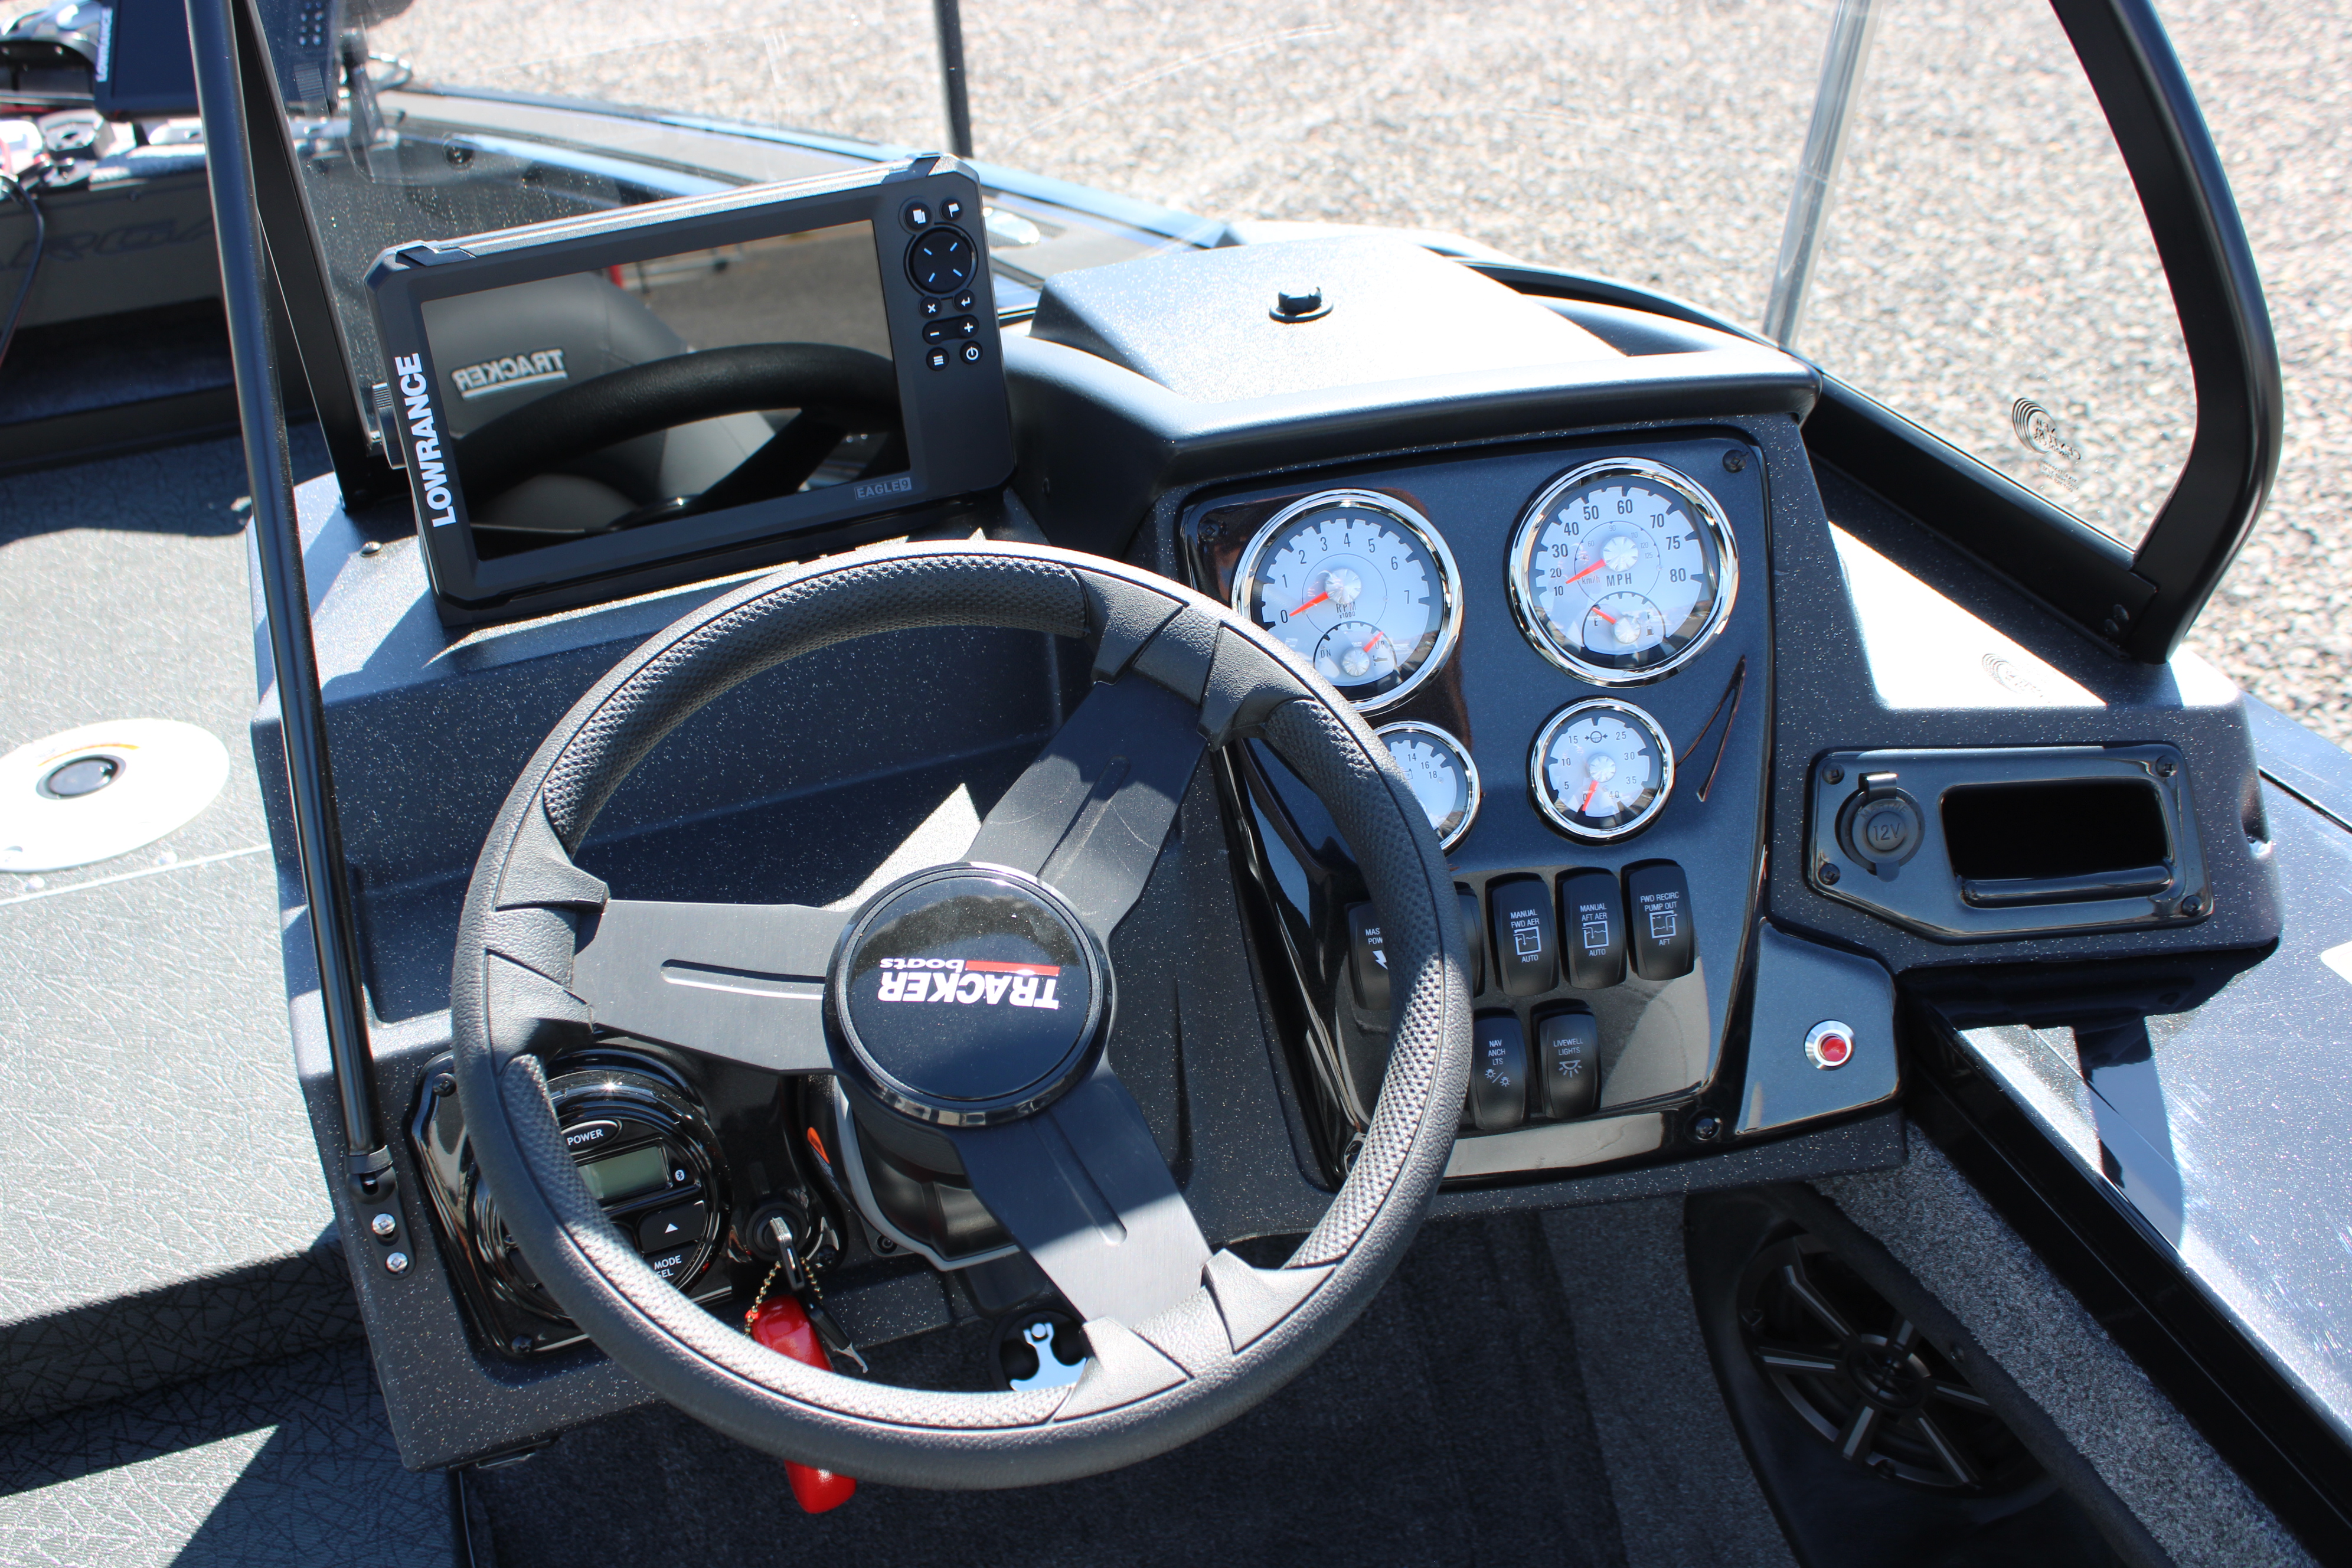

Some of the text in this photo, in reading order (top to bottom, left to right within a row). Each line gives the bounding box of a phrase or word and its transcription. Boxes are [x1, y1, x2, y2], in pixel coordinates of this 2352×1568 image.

[394, 352, 456, 528] LOWRANCE
[1617, 499, 1633, 514] 60
[1583, 505, 1599, 521] 50
[1650, 514, 1664, 529] 70
[1564, 522, 1580, 536] 40
[1320, 537, 1328, 551] 3
[1344, 533, 1351, 548] 4
[1368, 538, 1376, 553] 5
[1665, 535, 1681, 551] 75
[1552, 543, 1568, 558] 30
[1299, 550, 1306, 565] 2
[1391, 556, 1398, 570] 6
[1550, 568, 1562, 578] 20
[1670, 567, 1686, 583] 80
[1282, 574, 1288, 588] 1
[1582, 575, 1600, 584] km/h
[1606, 573, 1632, 587] MPH
[1554, 586, 1564, 596] 10
[1404, 590, 1410, 604] 7
[1336, 601, 1357, 613] RPM
[1280, 609, 1288, 623] 0
[1647, 612, 1651, 620] F
[1595, 618, 1598, 626] E
[1375, 641, 1384, 649] UP
[1320, 649, 1331, 658] DN
[1569, 736, 1578, 744] 15
[1616, 731, 1626, 740] 25
[1408, 753, 1416, 762] 14
[1624, 752, 1635, 760] 30
[1421, 761, 1429, 769] 16
[1562, 758, 1571, 766] 10
[1429, 770, 1438, 779] 18
[1626, 776, 1636, 785] 35
[1609, 790, 1619, 799] 40
[1860, 802, 1907, 819] MARINE
[1873, 823, 1900, 841] 12V
[1656, 891, 1679, 901] RECIRC
[1580, 903, 1607, 912] MANUAL
[1644, 901, 1677, 912] PUMP OUT
[1510, 909, 1537, 919] MANUAL
[1366, 927, 1380, 936] MAS
[1522, 955, 1538, 963] AUTO
[880, 958, 965, 973] boats
[878, 972, 1059, 1010] TRACKER
[1553, 1038, 1583, 1047] LIVEWELL
[1488, 1048, 1505, 1057] ANCH
[1558, 1047, 1580, 1056] LIGHTS
[567, 1129, 603, 1146] POWER
[654, 1255, 682, 1270] MODE
